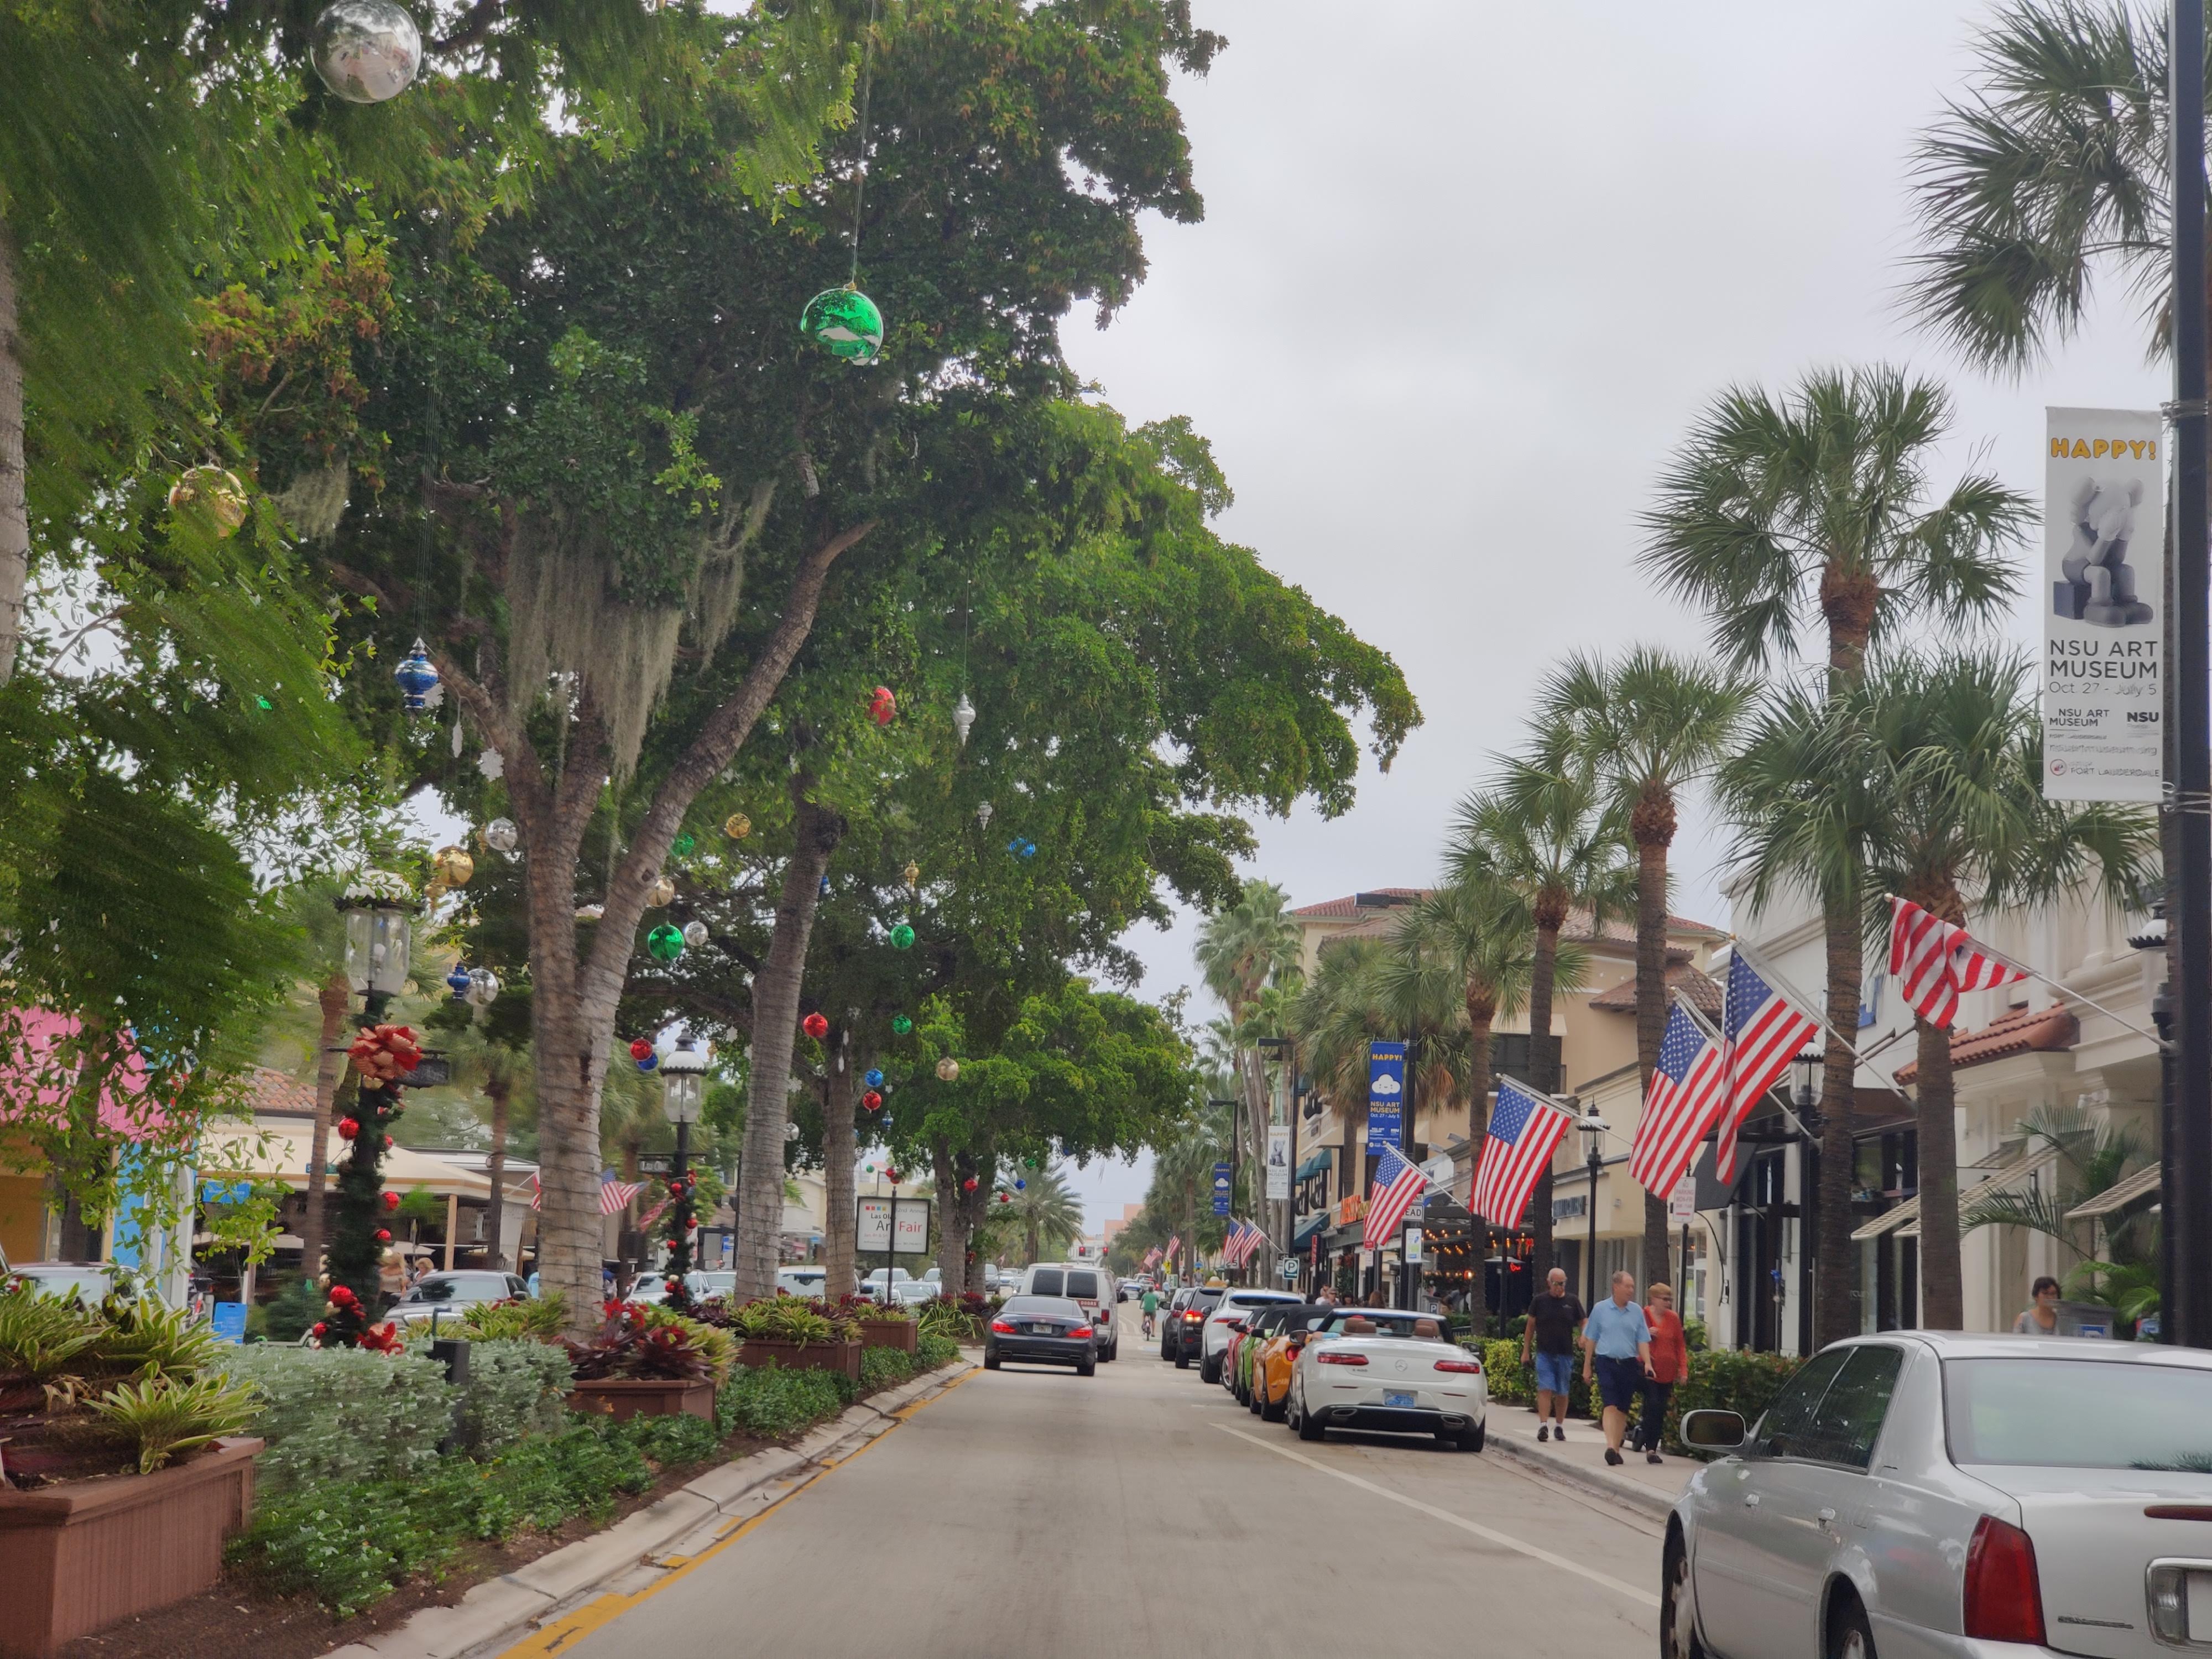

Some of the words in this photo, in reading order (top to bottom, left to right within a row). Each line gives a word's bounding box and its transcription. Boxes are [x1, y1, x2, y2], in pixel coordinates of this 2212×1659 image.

[2051, 437, 2156, 460] HAPPY!
[2051, 639, 2099, 656] NSU
[2108, 641, 2158, 657] ART
[2051, 660, 2157, 679] MUSEUM
[2049, 681, 2075, 693] Oct
[2081, 682, 2100, 694] 27
[2148, 683, 2157, 695] 5
[2058, 708, 2082, 717] NSU
[2126, 712, 2159, 723] NSU
[2049, 717, 2099, 727] MUSEUM
[876, 1220, 890, 1231] Ar
[899, 1221, 922, 1232] Fair
[1288, 1262, 1295, 1271] P
[1431, 1305, 1437, 1313] P
